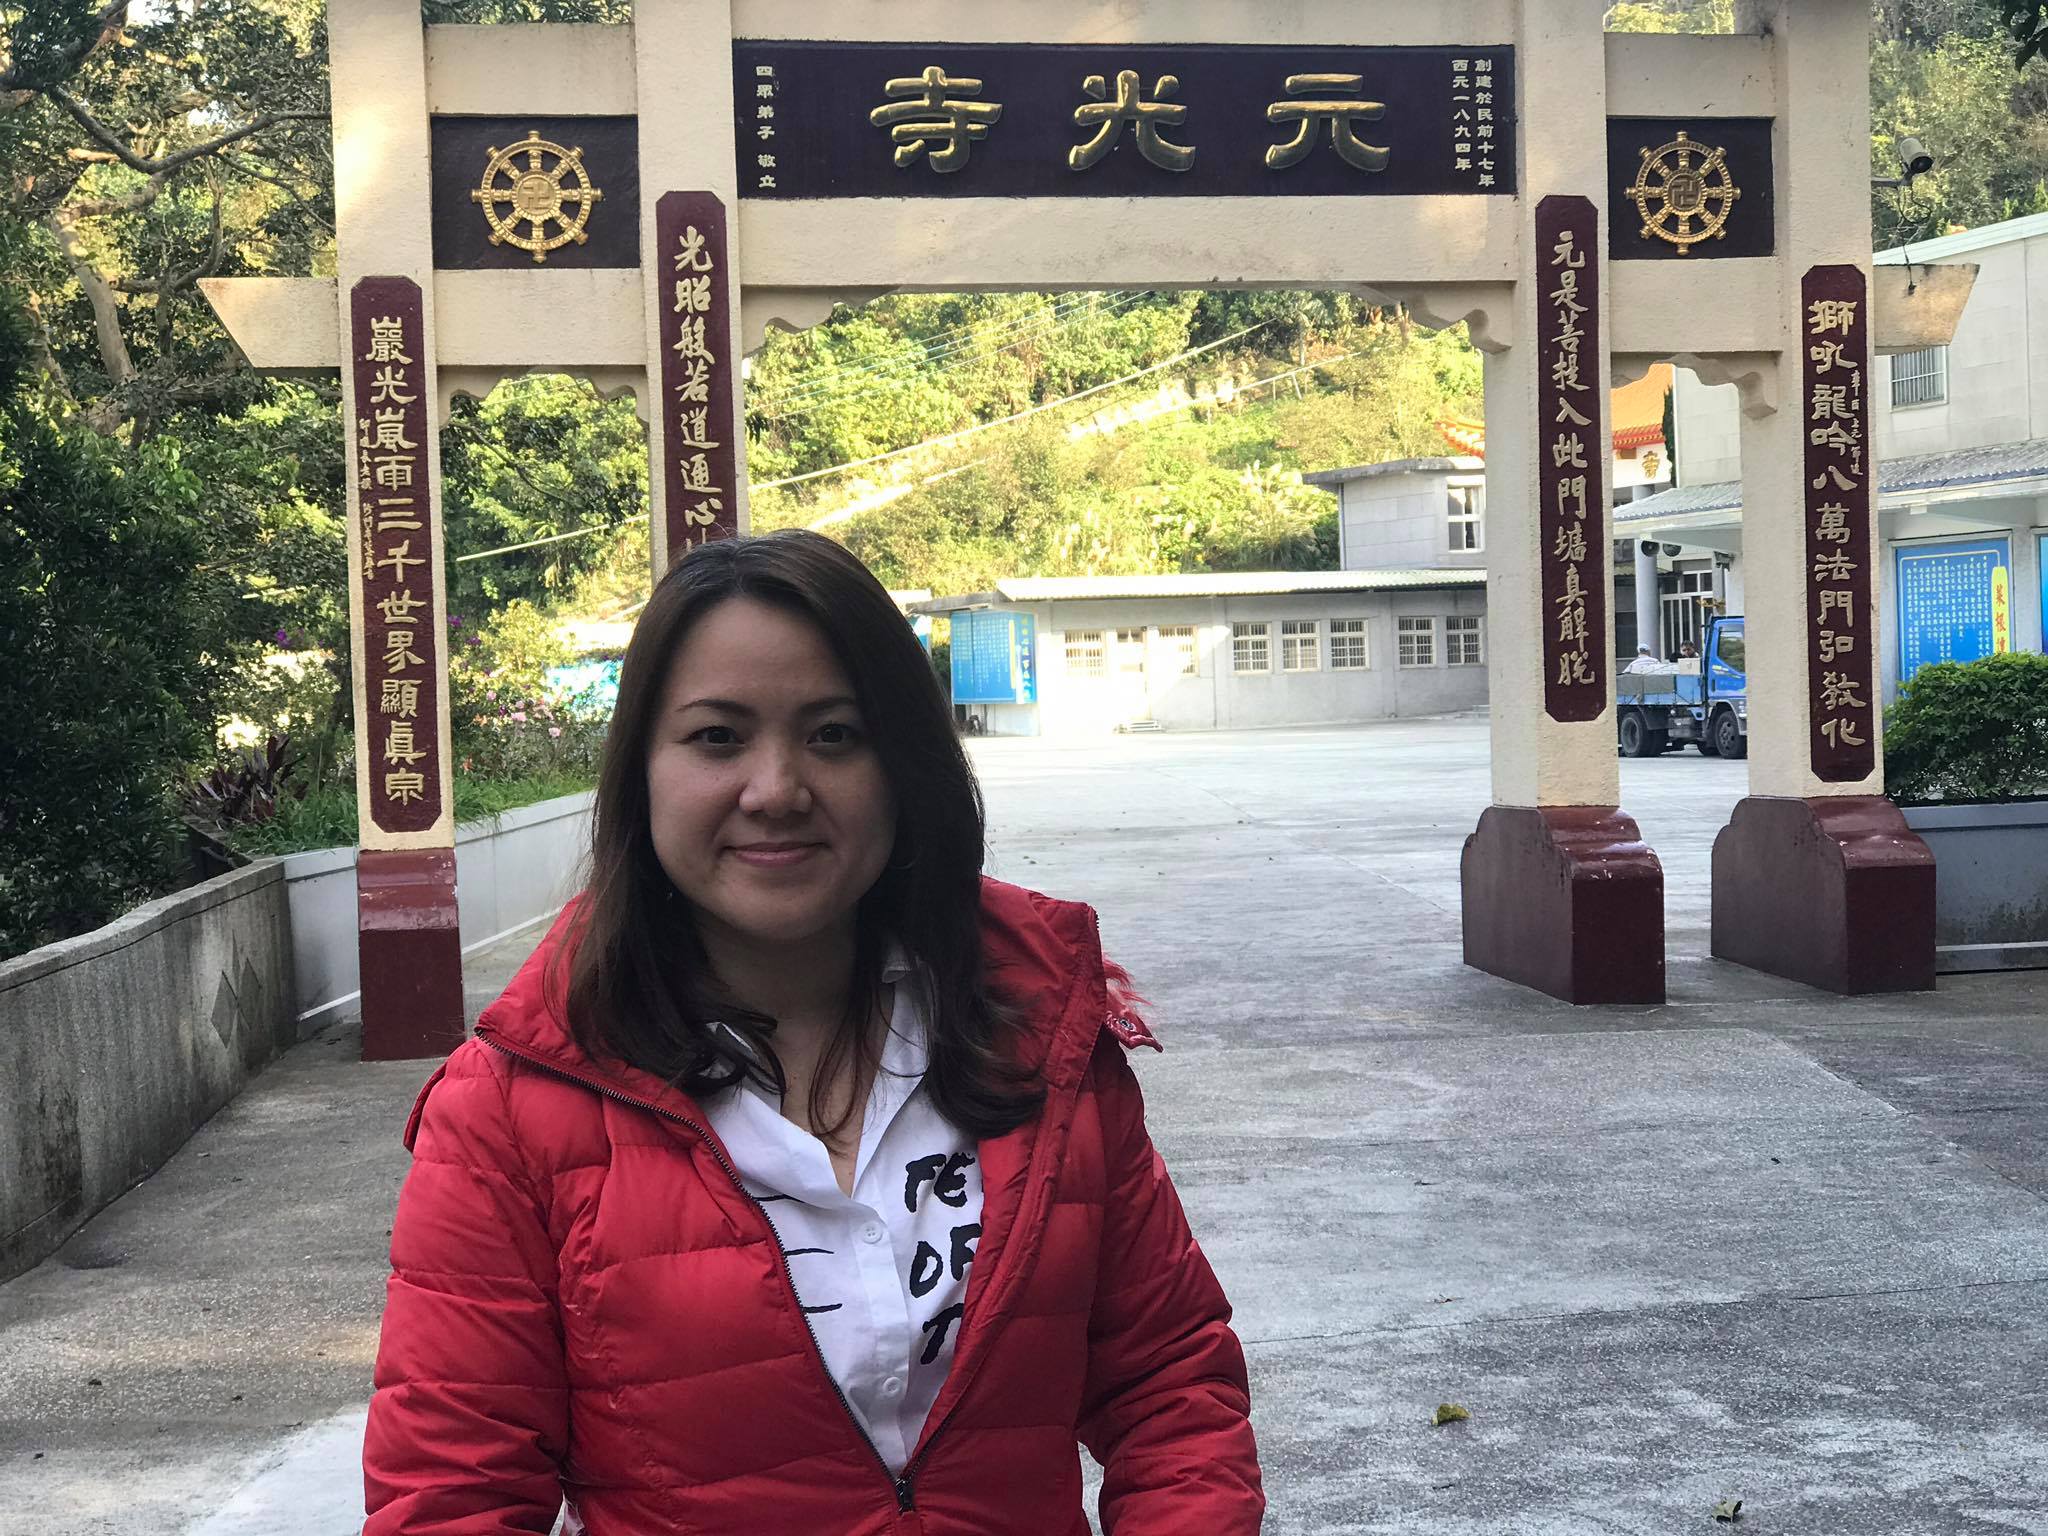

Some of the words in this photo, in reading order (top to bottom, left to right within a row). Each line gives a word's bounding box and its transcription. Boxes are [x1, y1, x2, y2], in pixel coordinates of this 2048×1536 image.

[869, 65, 1391, 173] 元光寺
[1451, 59, 1473, 170] 西元一八九四年
[1475, 59, 1496, 187] 創建於民前十七年
